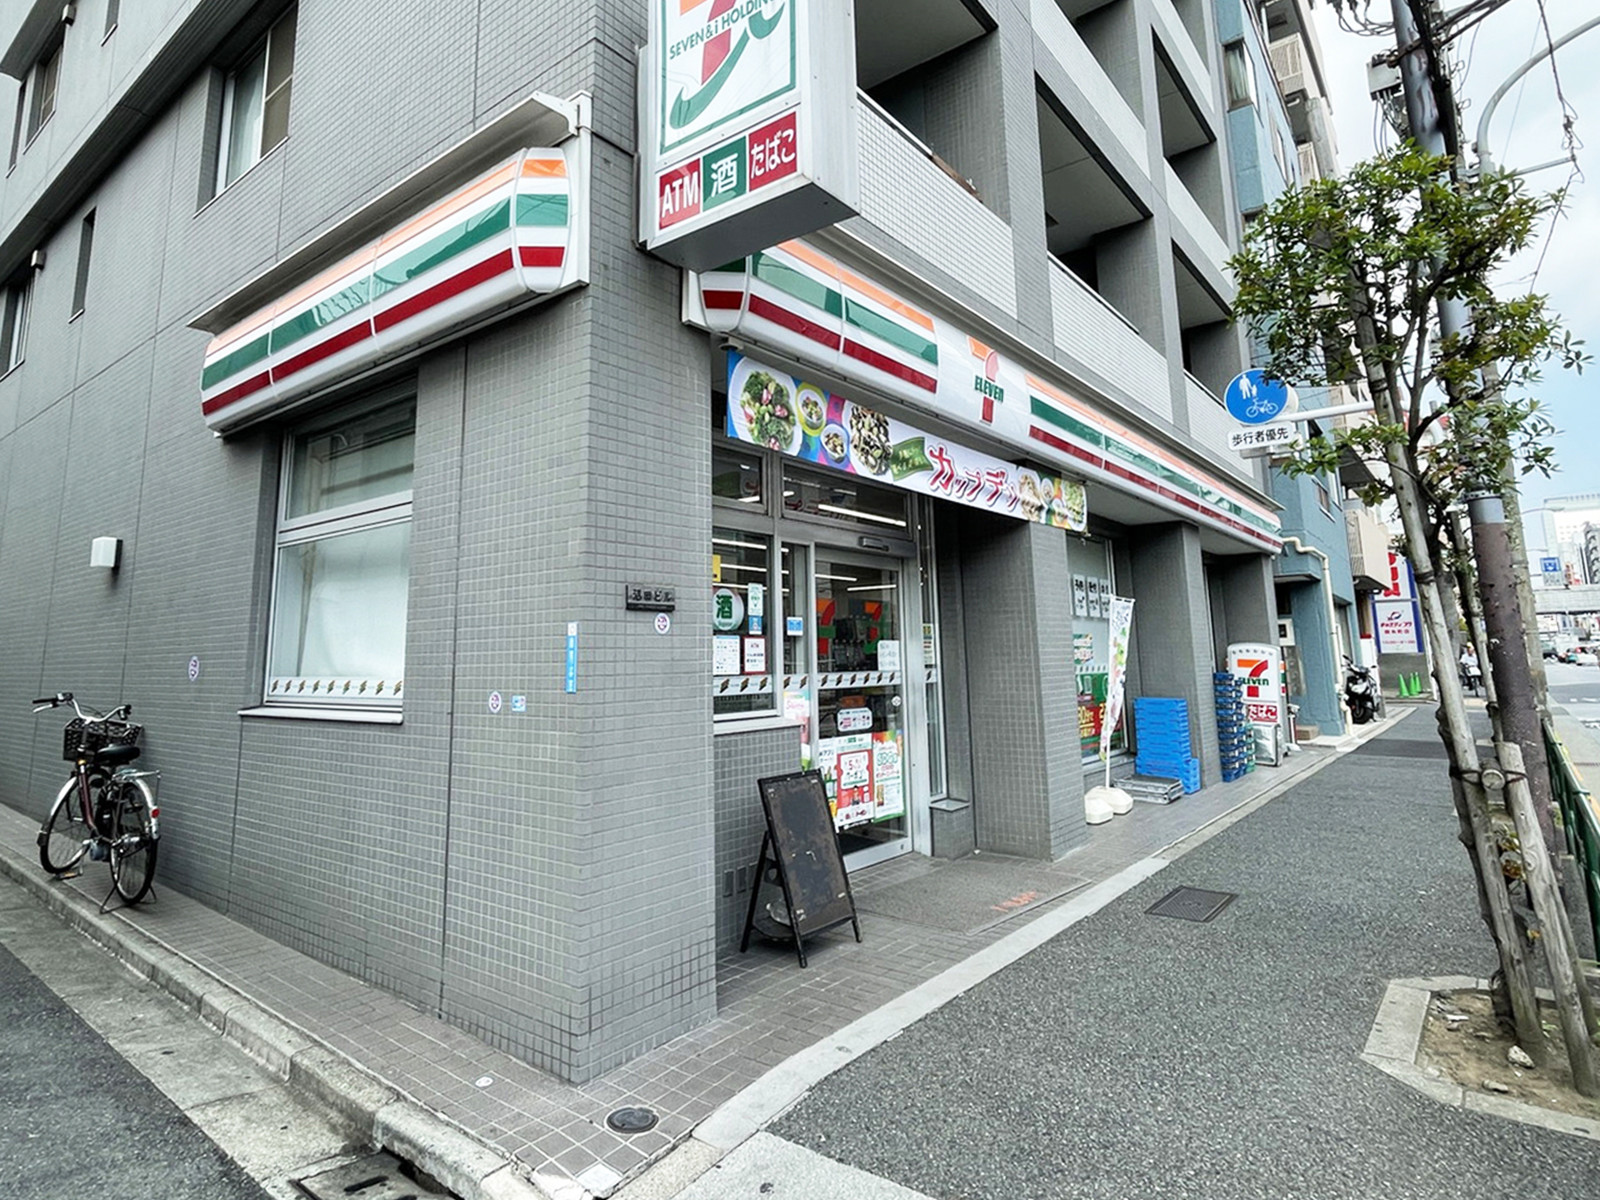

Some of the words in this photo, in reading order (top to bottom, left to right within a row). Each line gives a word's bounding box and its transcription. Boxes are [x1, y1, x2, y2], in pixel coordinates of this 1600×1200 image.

[710, 152, 738, 198] 酒
[750, 128, 796, 179] たばこ
[661, 170, 699, 218] ATM
[1232, 427, 1289, 447] 歩行者優先
[716, 594, 733, 619] 酒
